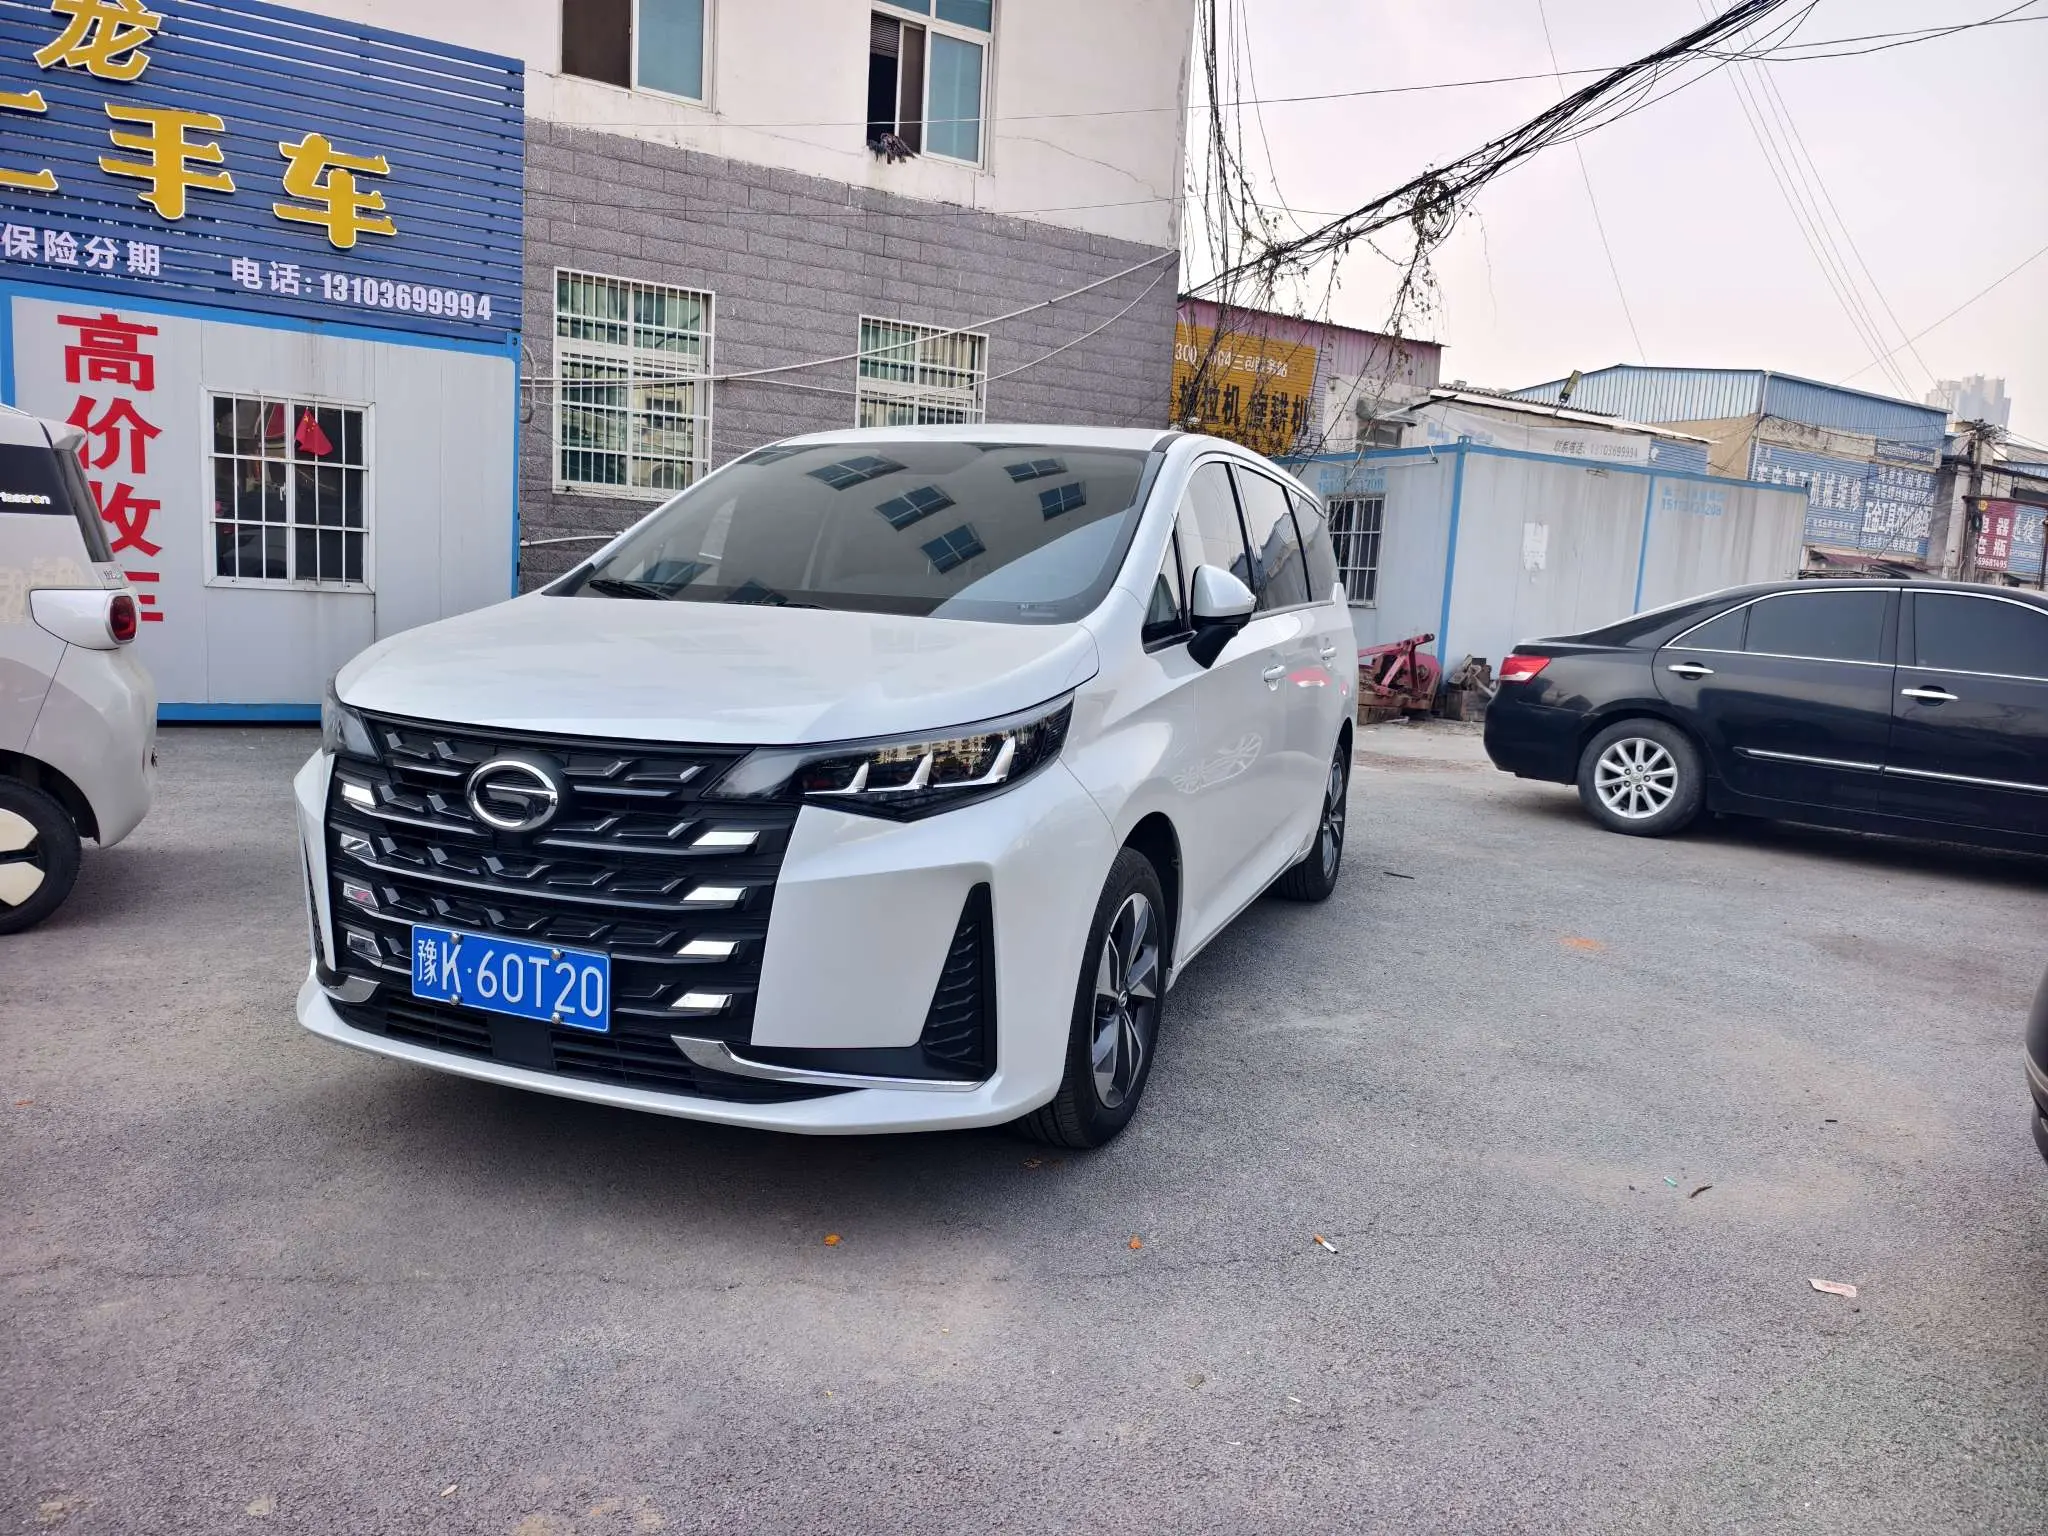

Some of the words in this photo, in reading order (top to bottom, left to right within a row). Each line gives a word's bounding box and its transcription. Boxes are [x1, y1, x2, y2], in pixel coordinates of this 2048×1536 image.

[33, 0, 162, 81] 龙
[0, 223, 161, 277] 保险分期
